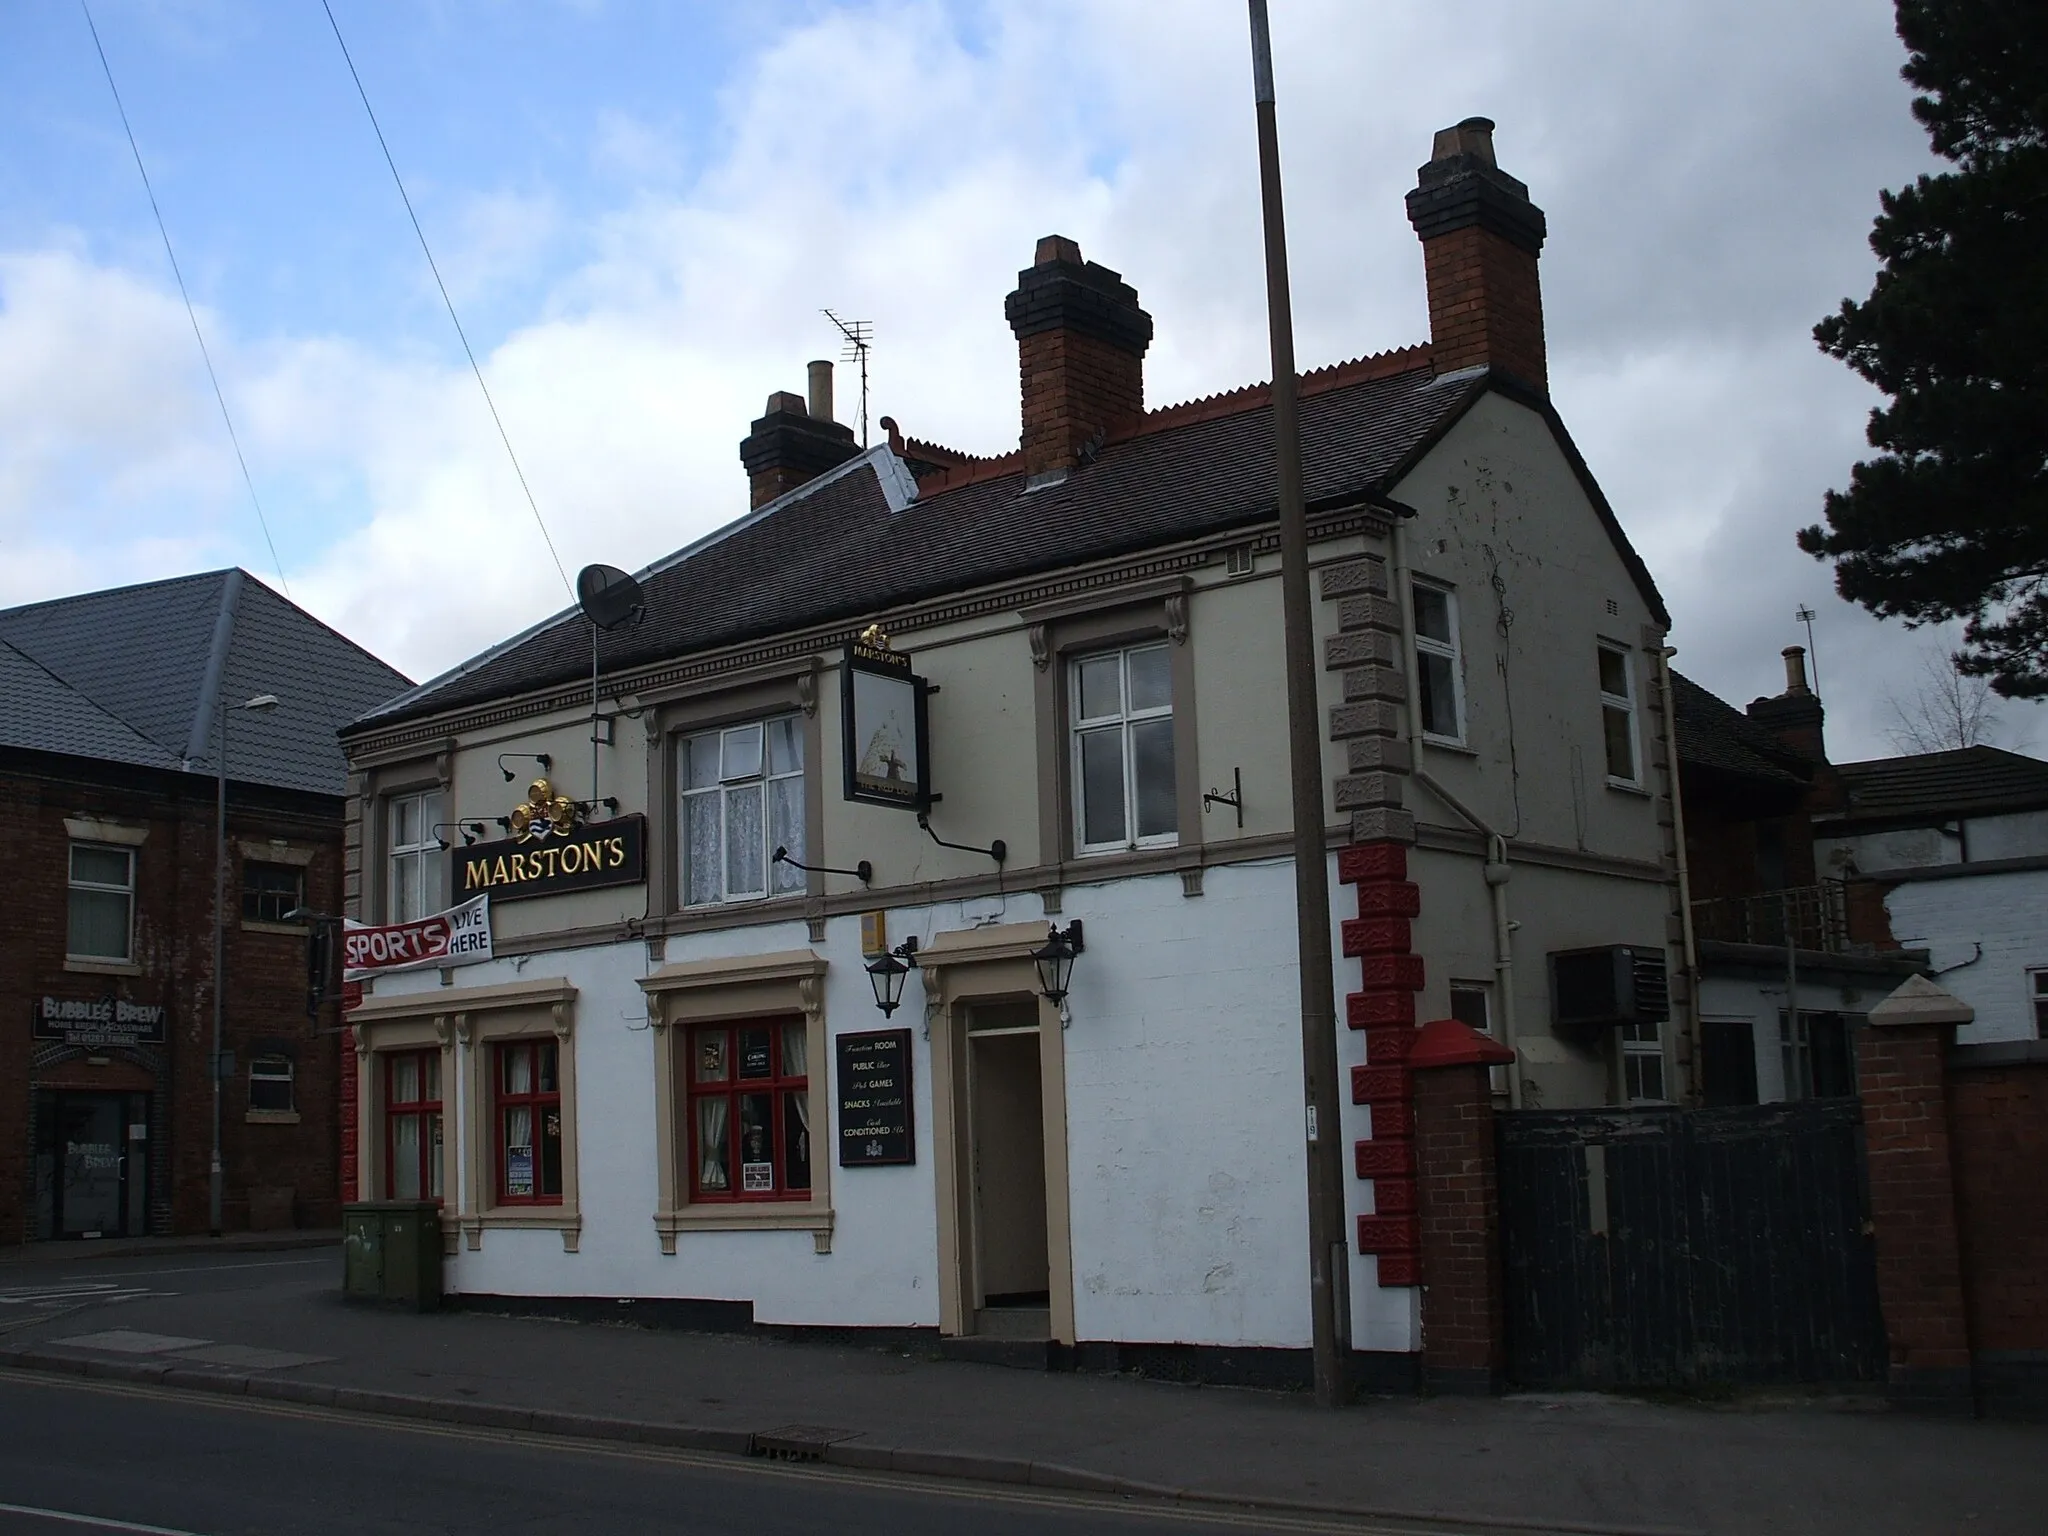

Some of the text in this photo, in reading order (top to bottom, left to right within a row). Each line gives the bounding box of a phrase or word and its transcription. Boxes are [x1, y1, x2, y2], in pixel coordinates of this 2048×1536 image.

[853, 644, 908, 667] MARSTON'S
[464, 836, 625, 890] MARSTON'S
[453, 906, 483, 930] LIVE
[346, 923, 488, 964] SPORTS HERE
[42, 996, 161, 1024] BUBBLES BREW
[874, 1041, 897, 1050] ROOM
[852, 1061, 875, 1071] PUBLIC
[869, 1079, 894, 1088] GAMES
[844, 1100, 870, 1109] SNACKS
[843, 1126, 891, 1137] CONDITIONED
